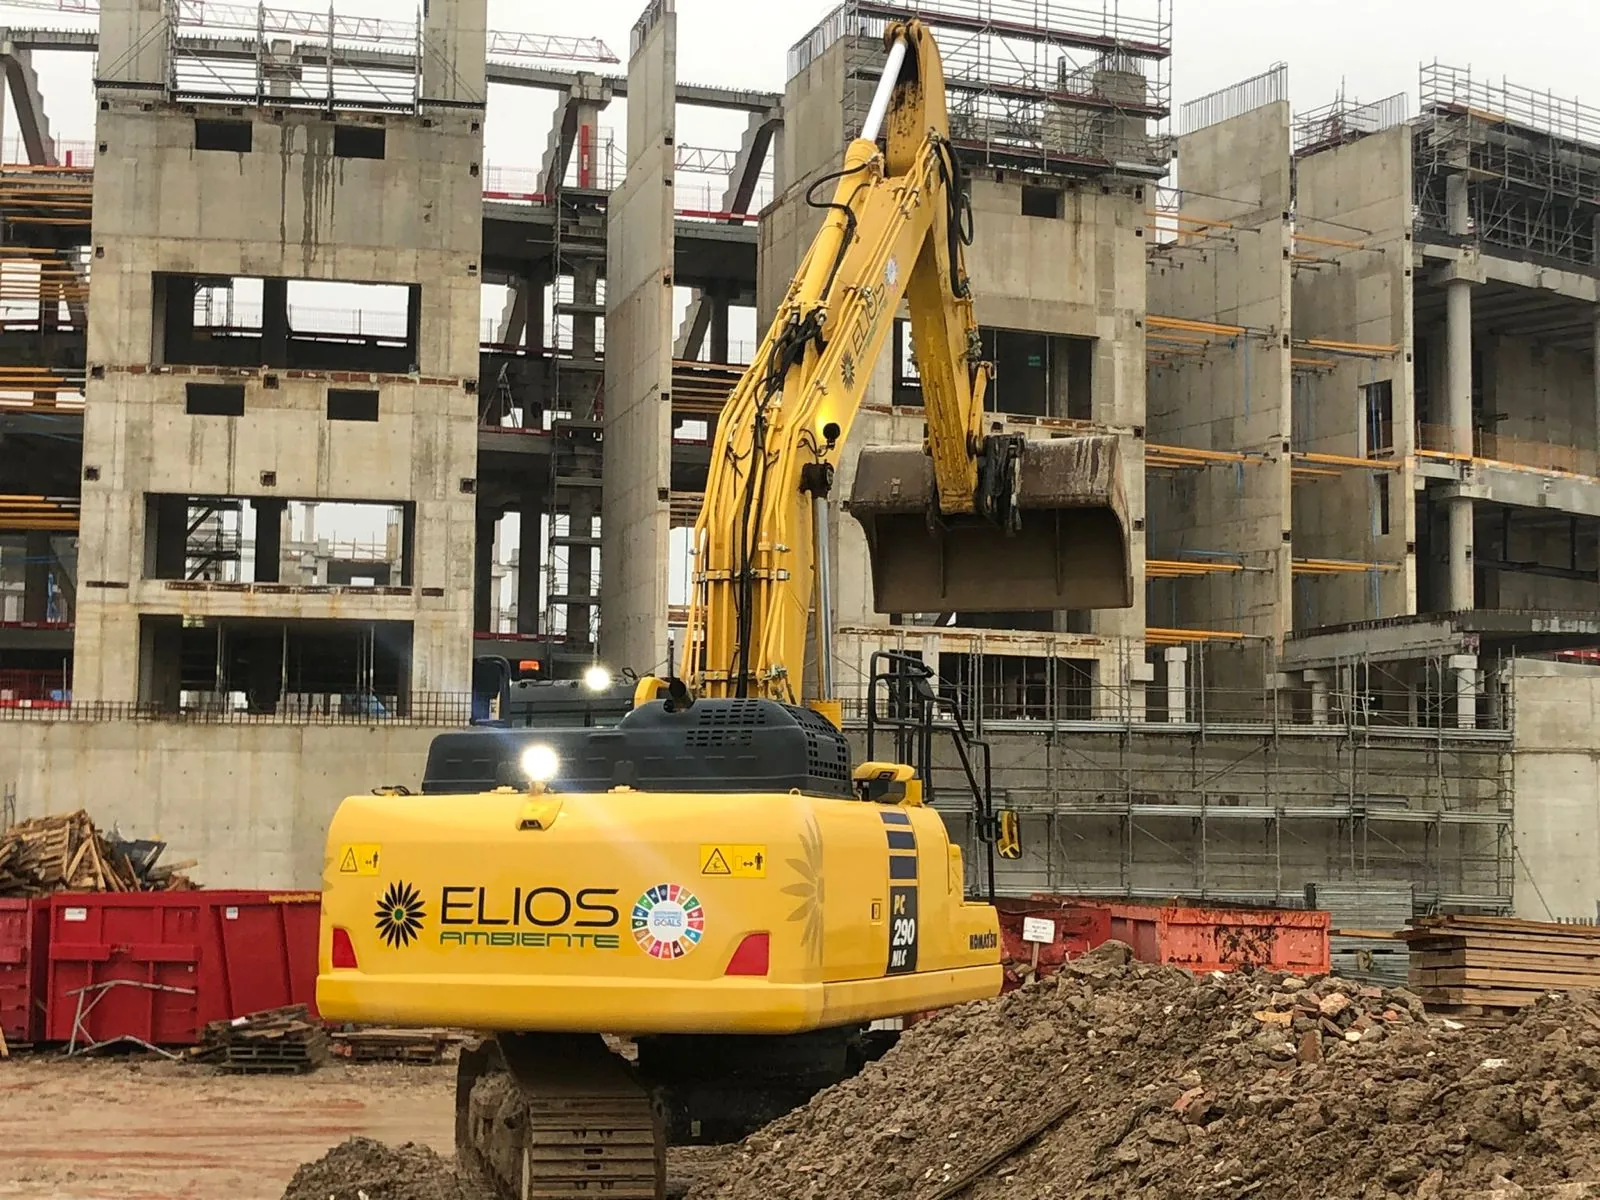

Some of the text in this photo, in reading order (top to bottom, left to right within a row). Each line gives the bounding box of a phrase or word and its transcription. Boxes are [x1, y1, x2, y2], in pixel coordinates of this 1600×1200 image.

[441, 886, 619, 927] ELIOS
[894, 894, 906, 915] PC
[653, 918, 682, 927] GOALS
[892, 918, 916, 946] 290
[440, 931, 619, 948] AMBIENTE
